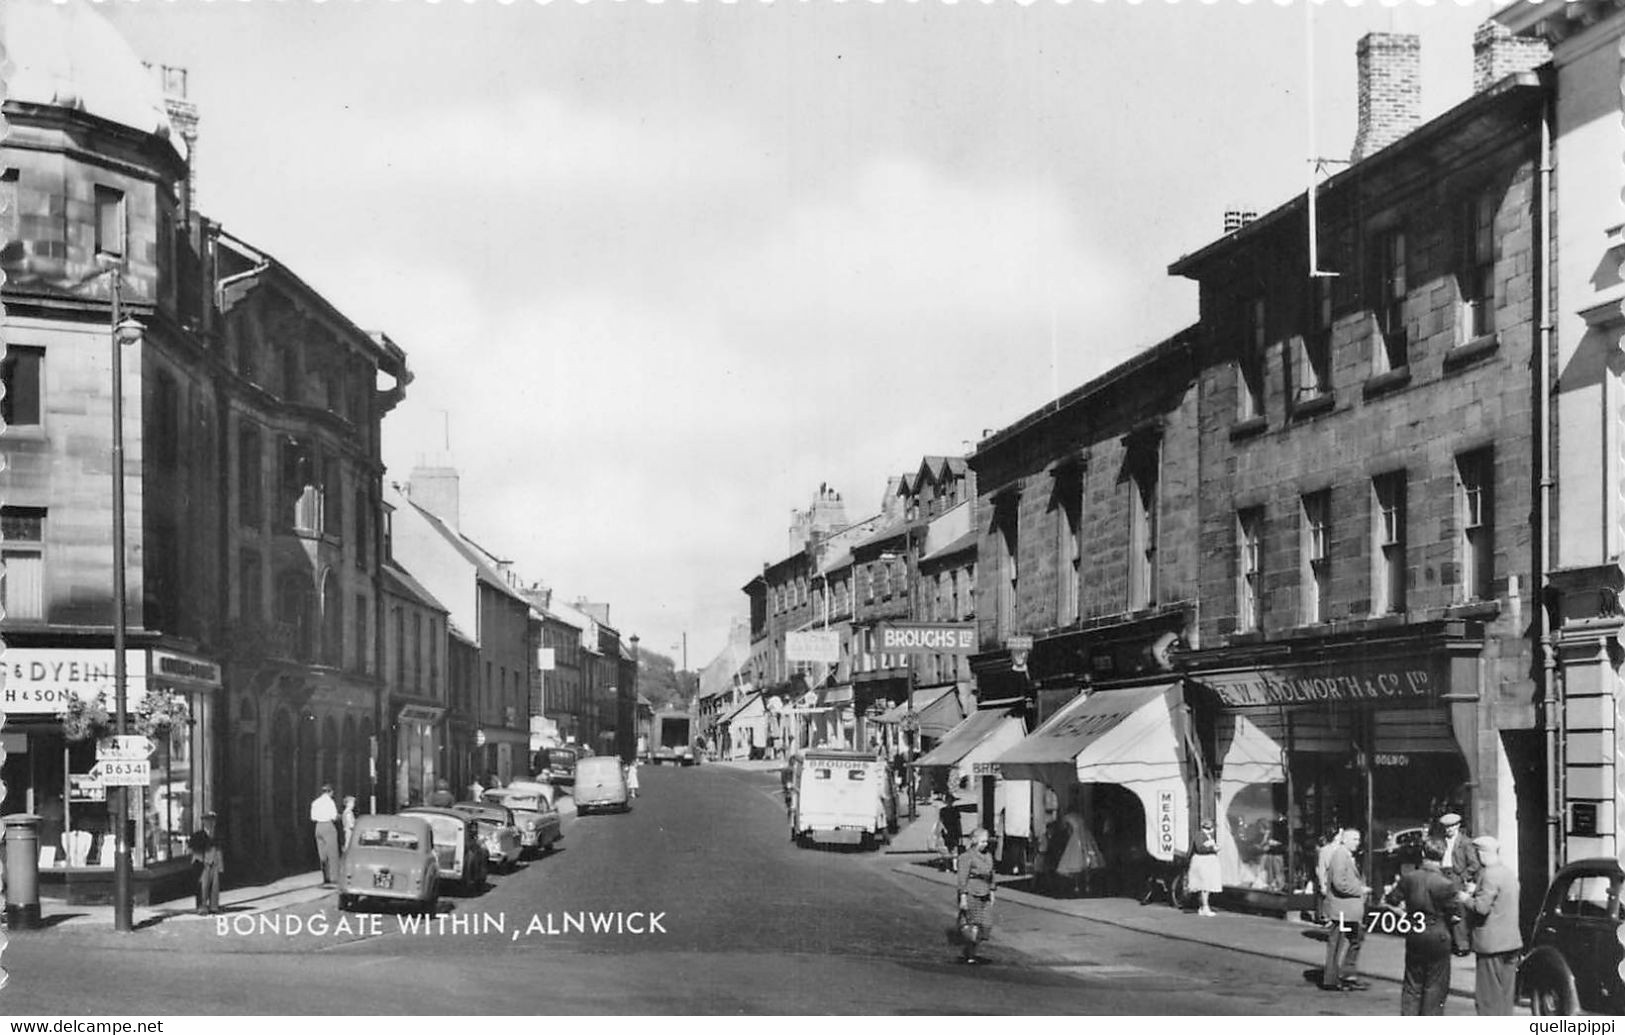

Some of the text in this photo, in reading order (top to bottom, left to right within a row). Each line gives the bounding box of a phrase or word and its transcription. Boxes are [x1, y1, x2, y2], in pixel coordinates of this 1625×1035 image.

[884, 629, 956, 648] BROUGHS
[30, 661, 109, 682] DYEIN
[1253, 675, 1365, 703] WOOLWORTH
[1365, 680, 1379, 698] &
[105, 763, 148, 775] B6341
[809, 761, 870, 769] BROUGHS
[1161, 793, 1173, 852] MEADOW
